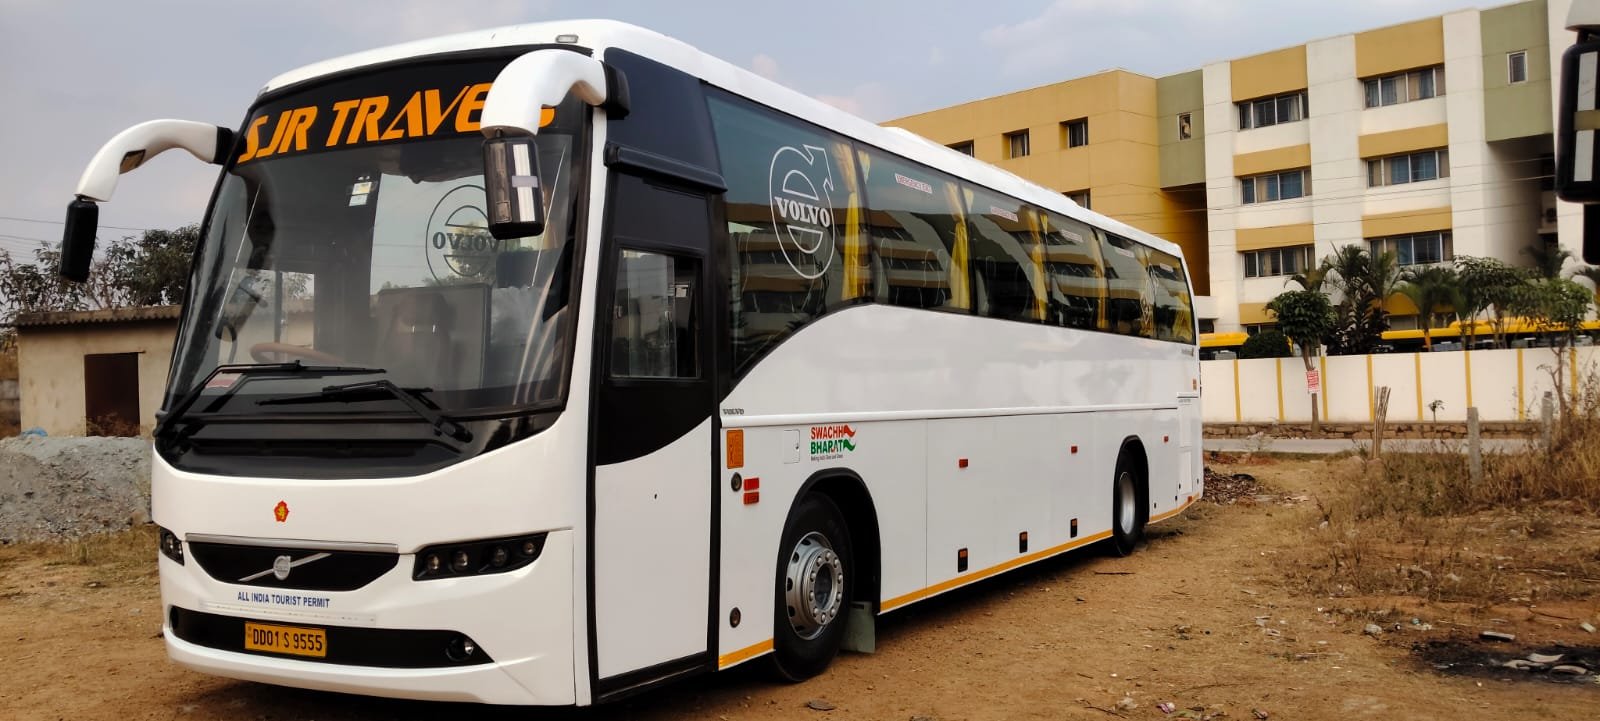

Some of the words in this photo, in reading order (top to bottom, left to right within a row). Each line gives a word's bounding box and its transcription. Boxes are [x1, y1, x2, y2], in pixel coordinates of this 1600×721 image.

[237, 106, 318, 164] SJR
[325, 82, 556, 147] TRAVE
[774, 196, 831, 228] VOLVO
[811, 426, 844, 439] SWACHH
[810, 440, 844, 454] BHARAT
[238, 592, 249, 601] ALL
[251, 593, 270, 604] INDIA
[271, 594, 302, 606] TOURIST
[303, 597, 330, 608] PERMIT
[253, 628, 280, 648] DD01
[283, 632, 290, 648] S
[293, 633, 323, 652] 9555
